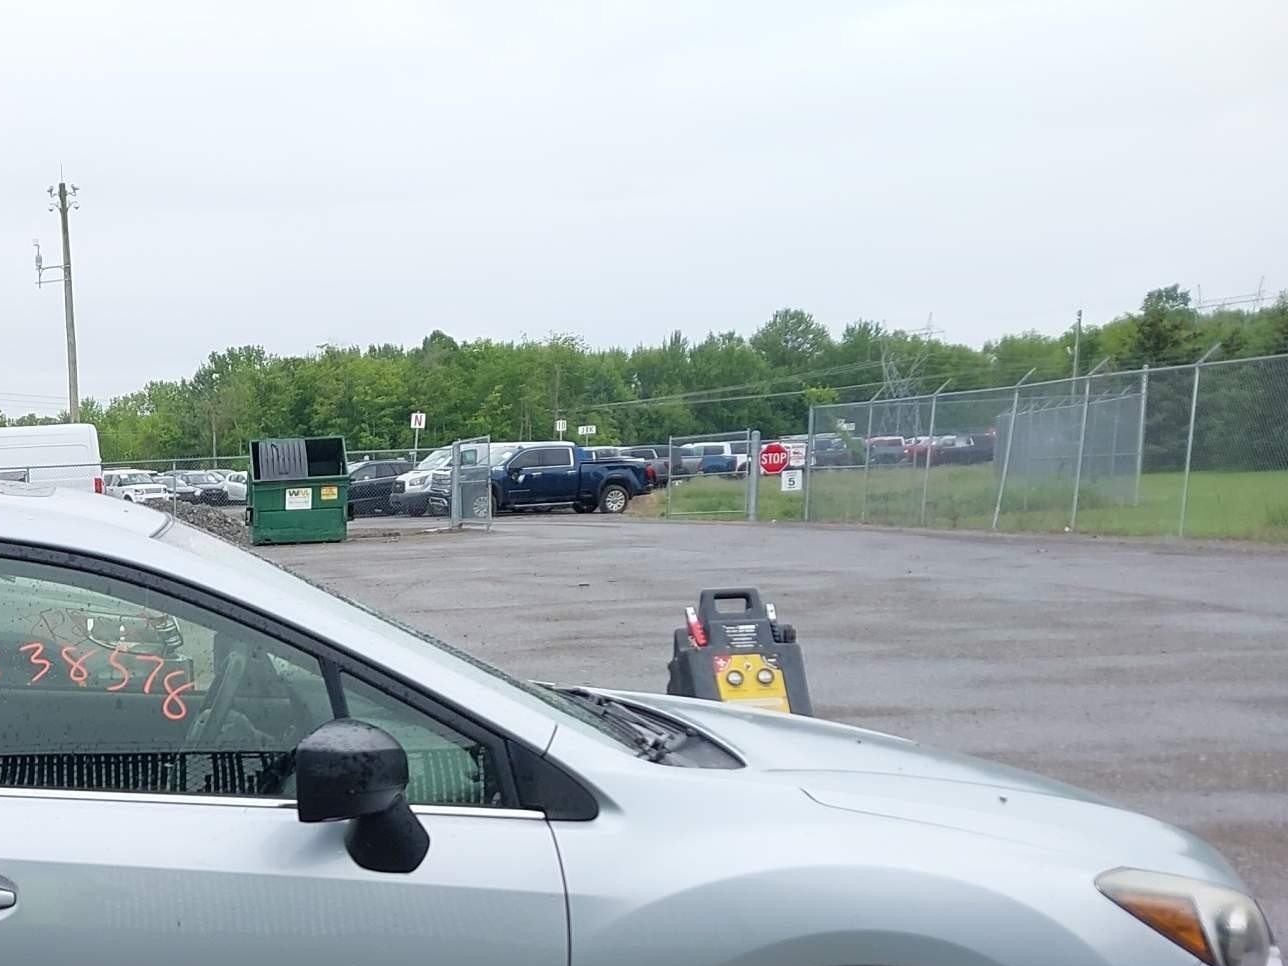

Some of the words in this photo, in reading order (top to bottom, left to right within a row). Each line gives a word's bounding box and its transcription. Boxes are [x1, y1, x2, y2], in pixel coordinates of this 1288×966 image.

[414, 414, 424, 427] N
[761, 452, 787, 465] STOP
[788, 477, 796, 486] 5
